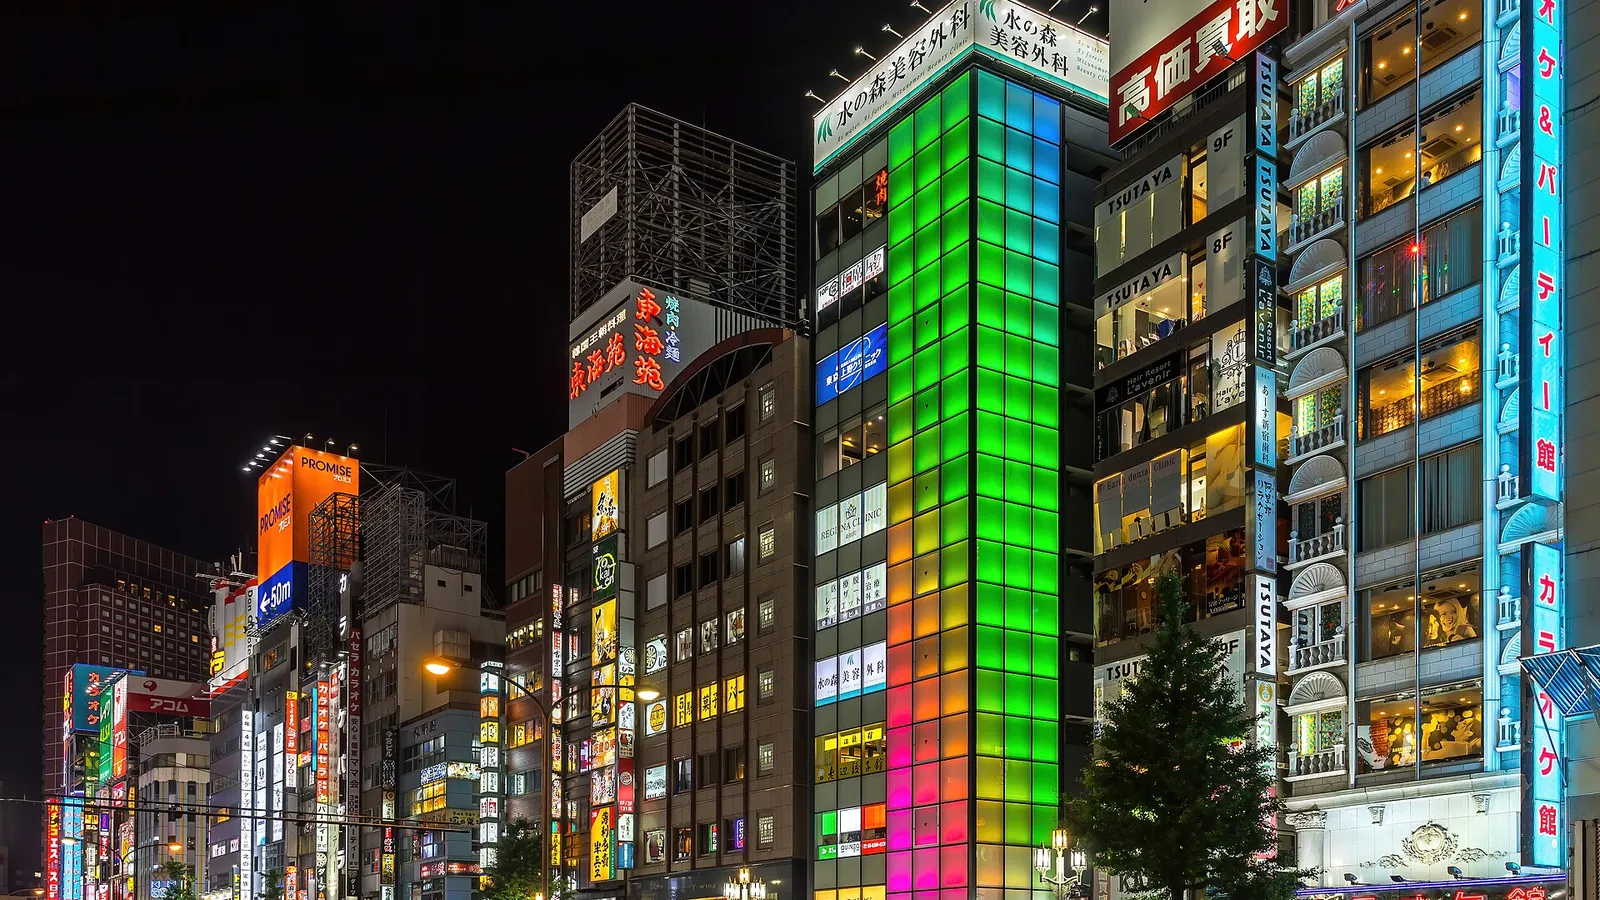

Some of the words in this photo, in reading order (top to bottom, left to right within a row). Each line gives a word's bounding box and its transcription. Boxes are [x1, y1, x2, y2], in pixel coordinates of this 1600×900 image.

[1003, 8, 1057, 47] 水の森
[836, 2, 970, 130] 水の森美容外科
[990, 25, 1068, 76] 美容外科
[1117, 0, 1278, 127] 高価買取
[1259, 61, 1271, 146] TSUTAYA
[1213, 129, 1233, 153] 9F
[1107, 166, 1172, 215] TSUTAYA
[1260, 166, 1271, 251] TSUTAYA
[1213, 231, 1233, 254] 8F
[1106, 263, 1172, 309] TSUTAYA
[632, 287, 665, 391] 東海苑
[1265, 321, 1273, 362] Resort
[570, 332, 626, 400] 東海苑
[1127, 373, 1143, 386] Hair
[1145, 361, 1171, 380] Resort
[1127, 369, 1171, 394] L'avenir
[1216, 387, 1232, 398] Hair
[302, 457, 352, 477] PROMISE
[333, 474, 352, 484] プロミス
[1128, 469, 1150, 481] denta
[1153, 457, 1176, 472] Clinic
[260, 493, 291, 536] PROMISE
[271, 580, 291, 609] 50m
[1260, 582, 1271, 669] TSUTAYA
[350, 631, 360, 662] パセラ
[150, 698, 188, 712] アコム
[318, 685, 328, 729] カラオケ
[350, 667, 360, 712] カラオケ
[318, 743, 328, 777] パセラ
